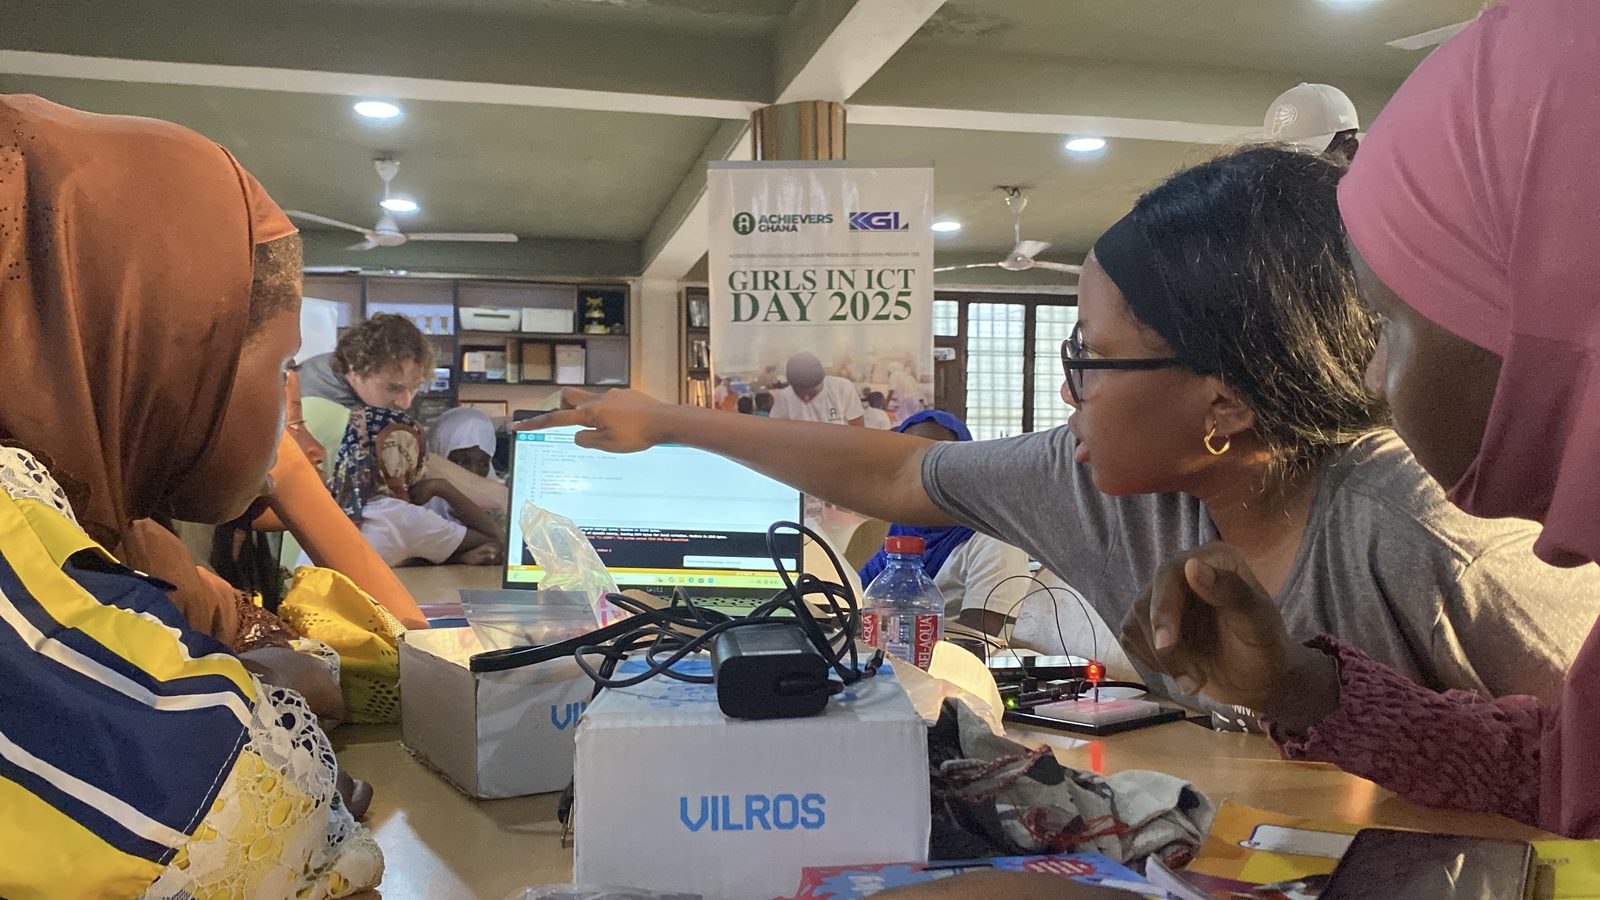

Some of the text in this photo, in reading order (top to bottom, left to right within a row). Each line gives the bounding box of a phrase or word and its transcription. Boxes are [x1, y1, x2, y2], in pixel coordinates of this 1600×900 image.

[758, 213, 833, 224] ACHIEVERS
[758, 224, 799, 233] GHANA
[849, 211, 909, 231] KGL
[728, 268, 915, 291] GIRLS IN ICT
[730, 290, 912, 322] DAY 2025
[680, 792, 826, 833] VILROS
